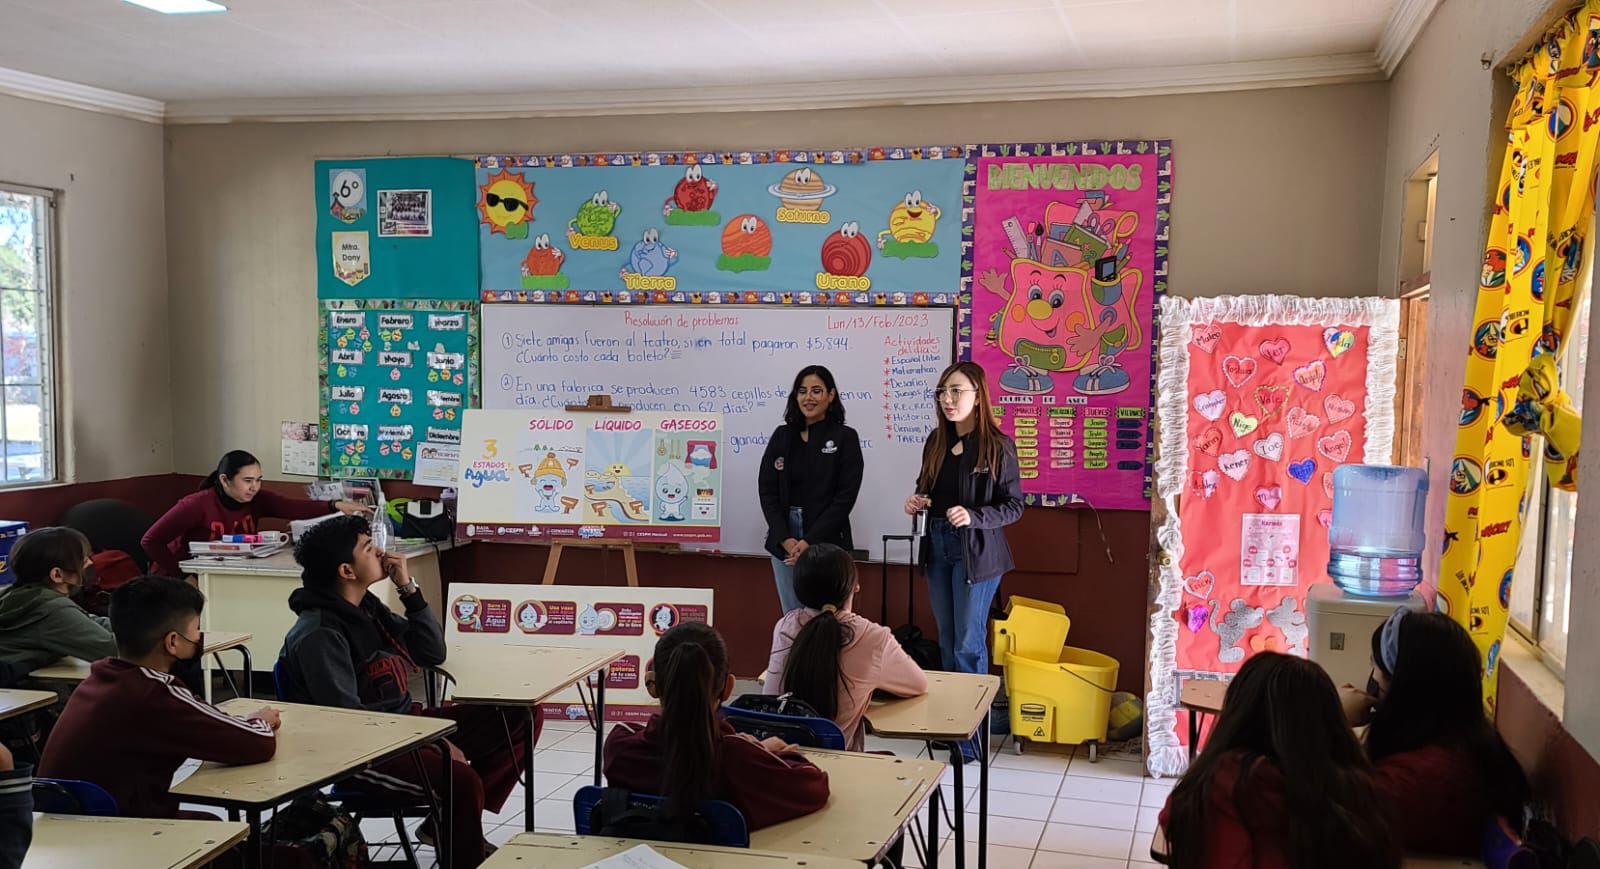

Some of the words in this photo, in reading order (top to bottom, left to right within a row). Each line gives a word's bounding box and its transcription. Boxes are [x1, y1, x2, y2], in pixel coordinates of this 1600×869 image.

[776, 207, 830, 223] Saturno
[569, 234, 618, 250] Venus
[342, 254, 361, 262] Dany
[625, 274, 676, 290] Tierra
[816, 272, 870, 291] Urano
[336, 316, 357, 324] Enero
[381, 317, 410, 325] Febrero
[624, 310, 673, 328] Resolución
[677, 313, 689, 328] de
[692, 312, 739, 331] problemas
[515, 329, 543, 348] Siete
[546, 334, 579, 352] amigas
[584, 330, 620, 347] fueron
[625, 330, 636, 347] al
[719, 331, 746, 347] total
[752, 339, 798, 357] pagaron
[884, 331, 941, 347] Actividades
[337, 352, 355, 360] Abril
[384, 355, 406, 365] Mayo
[435, 356, 455, 365] Junio
[593, 349, 619, 362] cada
[627, 348, 670, 362] boleto?
[338, 390, 355, 398] Julio
[515, 376, 532, 392] En
[536, 383, 556, 392] una
[689, 385, 727, 398] 4583
[731, 386, 772, 402] cepillos
[673, 403, 690, 413] en
[698, 402, 716, 413] 62
[893, 413, 931, 422] Historia
[660, 419, 717, 430] GASEOSO
[481, 439, 497, 459] 3
[472, 461, 505, 469] ESTADOS
[464, 467, 510, 489] Agua
[485, 618, 506, 626] Agua
